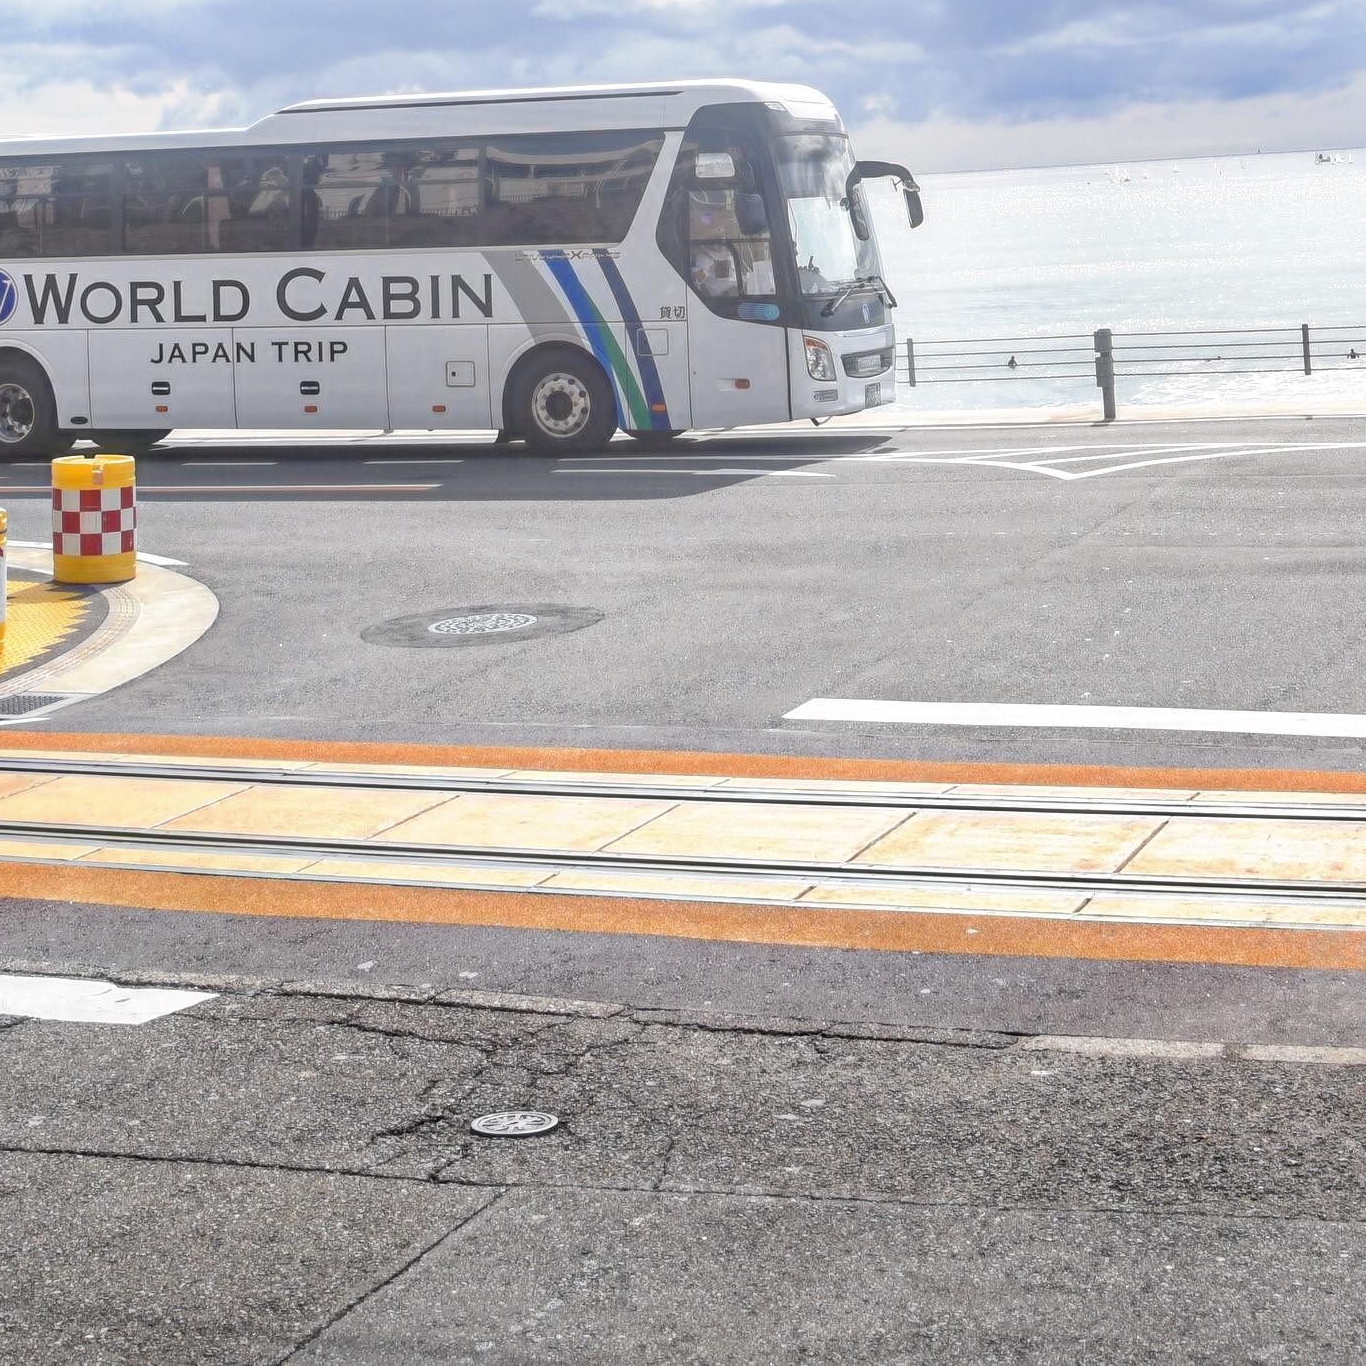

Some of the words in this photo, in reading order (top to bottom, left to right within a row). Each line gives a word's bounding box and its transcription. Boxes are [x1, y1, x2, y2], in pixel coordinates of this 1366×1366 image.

[23, 273, 250, 325] WORLD
[276, 267, 493, 322] CABIN
[660, 306, 685, 319] 貸切
[150, 342, 256, 364] JAPAN
[272, 341, 348, 362] TRIP
